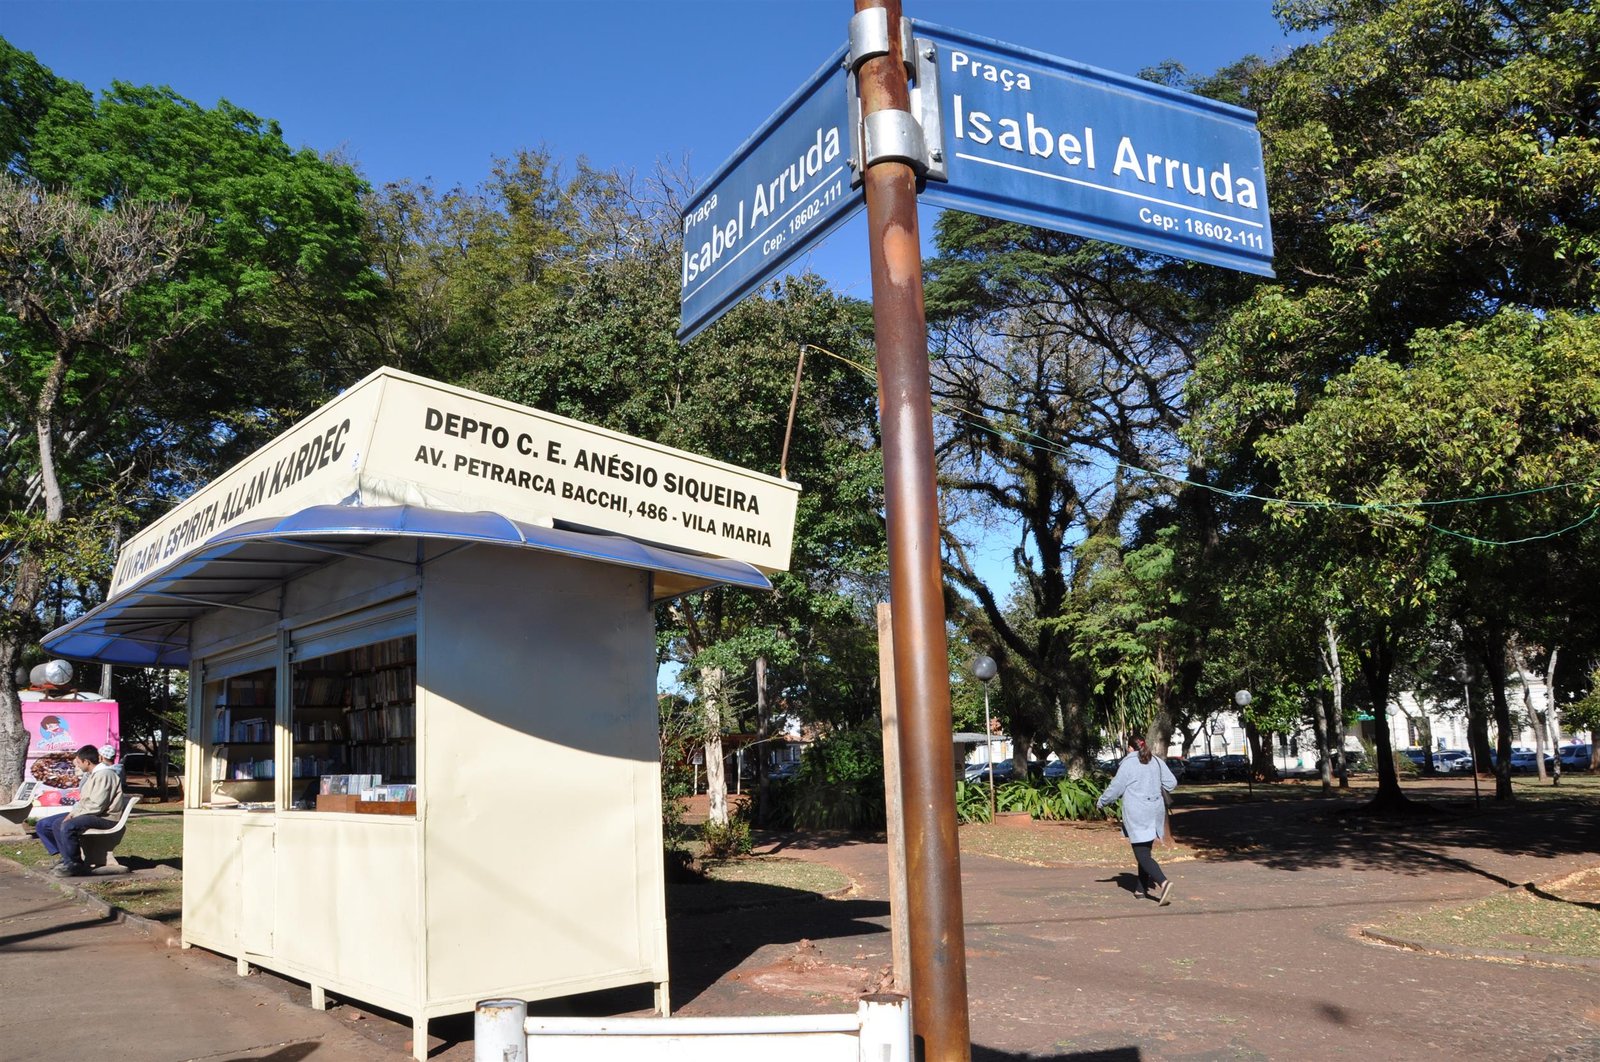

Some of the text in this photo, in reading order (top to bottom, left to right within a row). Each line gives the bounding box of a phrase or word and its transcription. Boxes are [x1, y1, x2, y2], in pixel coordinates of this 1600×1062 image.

[951, 51, 1031, 91] Praça
[953, 94, 1258, 209] Isabel Arruda
[683, 127, 840, 287] Isabel Arruda
[685, 194, 717, 234] Praça
[763, 180, 842, 255] Cep: 18602-111
[1139, 208, 1263, 249] Cep: 18602-111
[117, 536, 164, 587] LIVRARIA
[218, 467, 270, 528] ALLAN
[267, 418, 350, 498] KARDEC
[414, 445, 447, 469] AV.
[453, 454, 556, 496] PETRARCA
[561, 481, 633, 518] BACCHI,
[636, 501, 668, 522] 486
[682, 512, 716, 535] VILA
[722, 522, 772, 547] MARIA
[424, 407, 760, 515] DEPTO C. E. ANÉSIO SIQUEIRA
